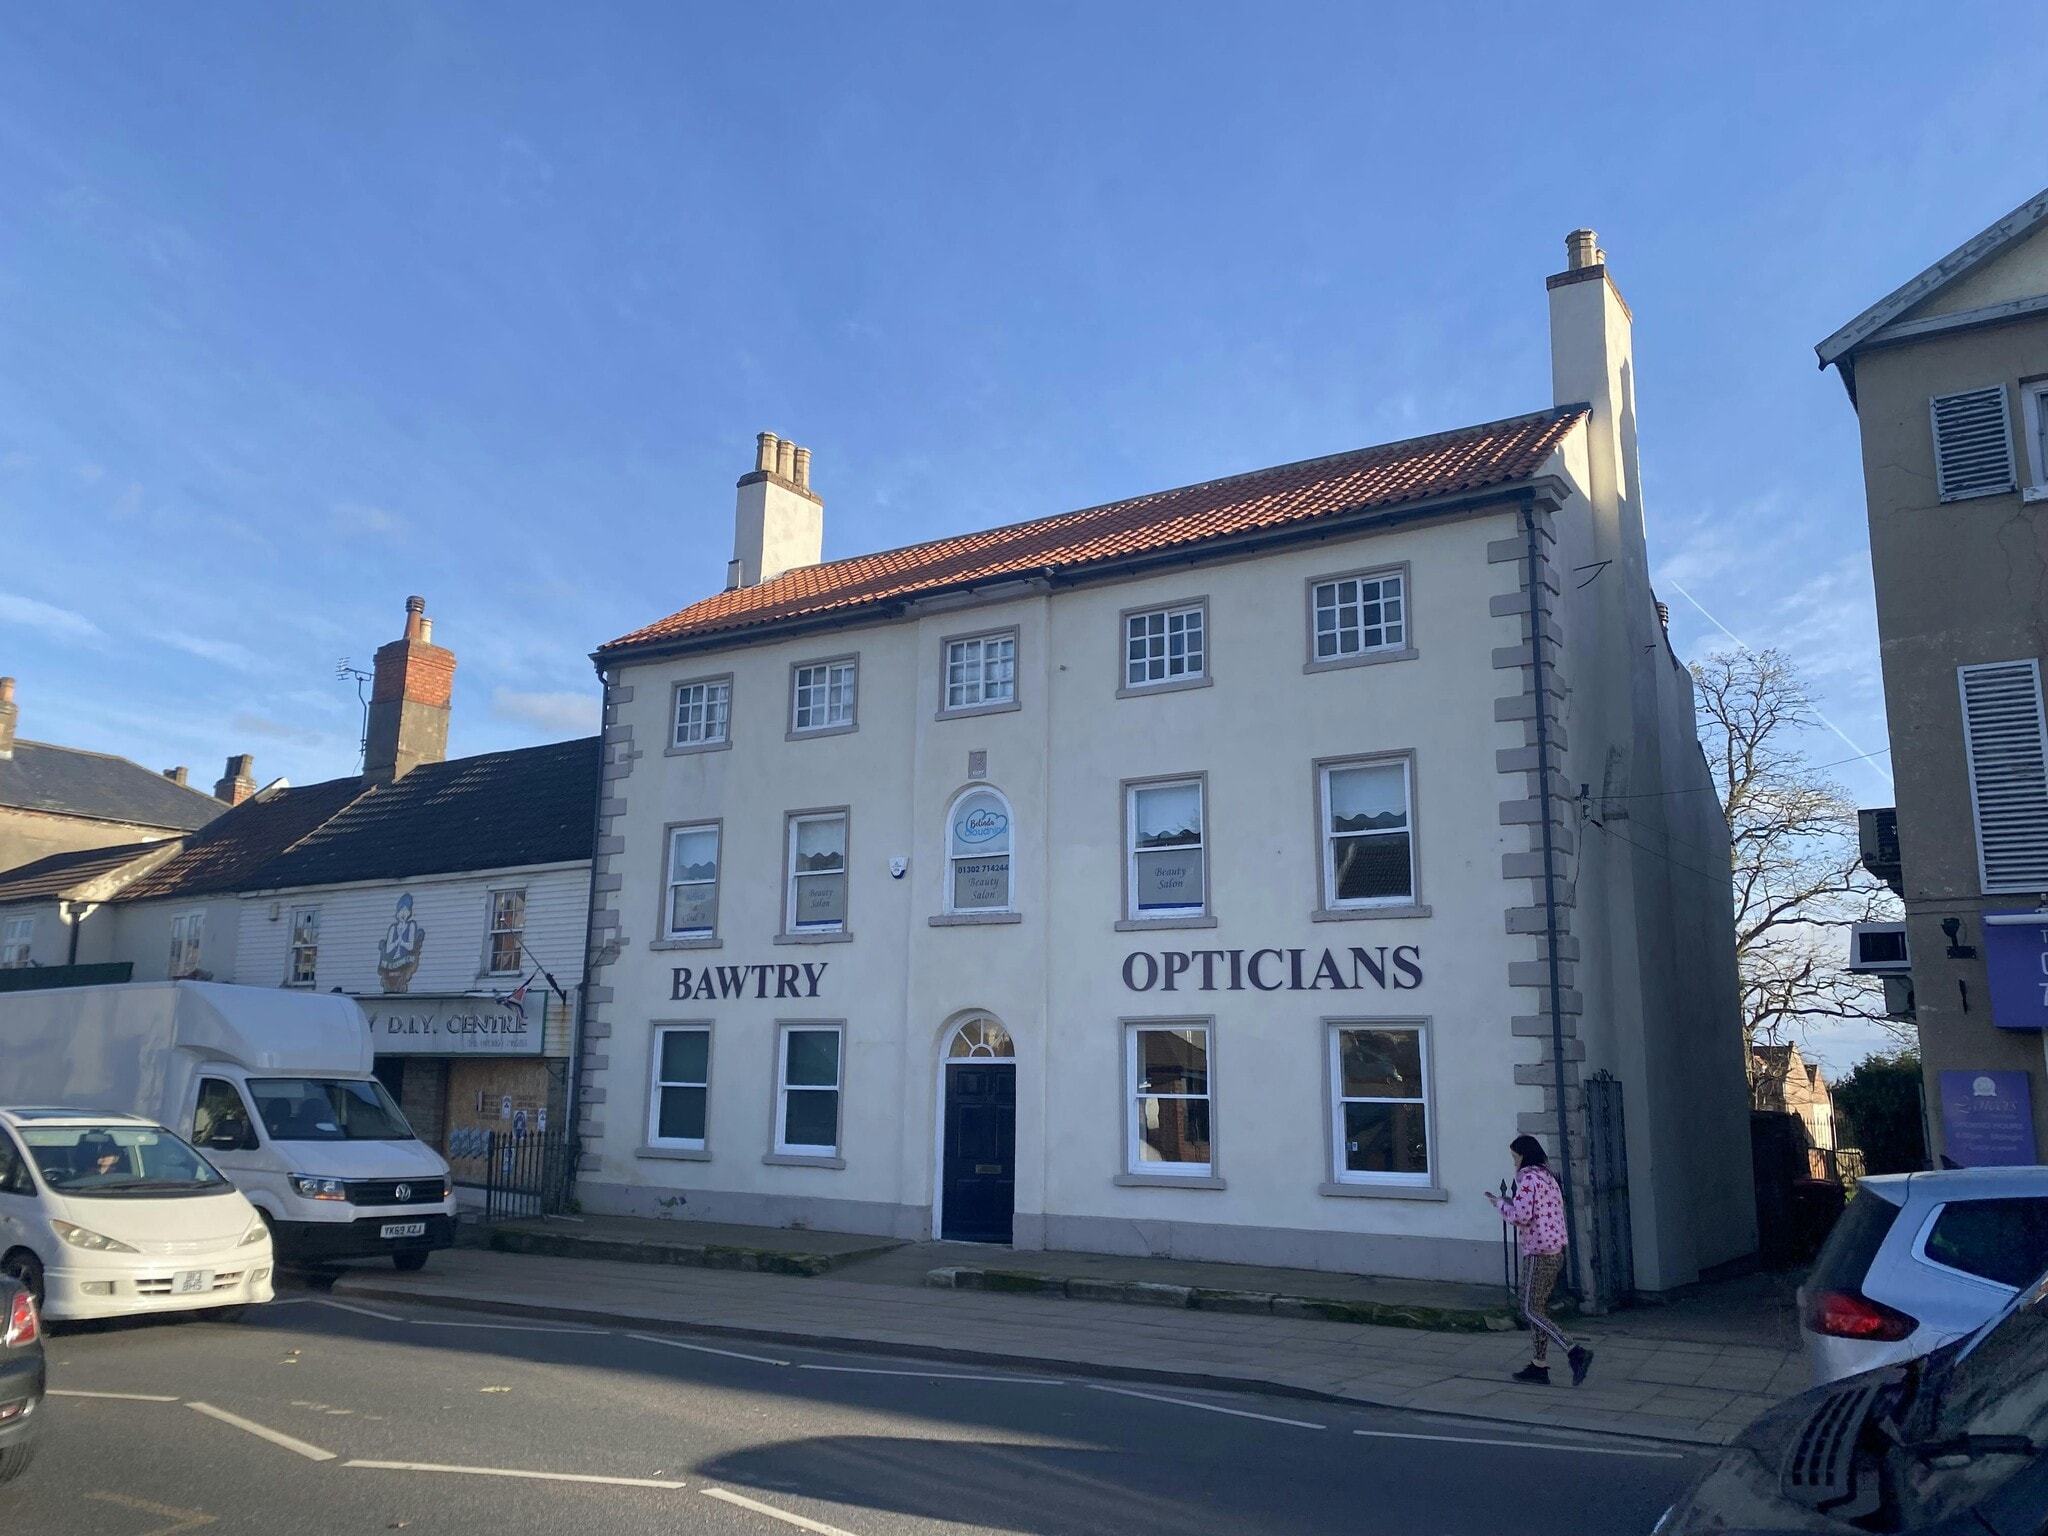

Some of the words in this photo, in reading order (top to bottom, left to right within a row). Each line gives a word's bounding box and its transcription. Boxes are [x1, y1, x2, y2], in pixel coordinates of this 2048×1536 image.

[970, 817, 995, 829] Belinda
[958, 866, 980, 874] 01302
[982, 863, 1009, 873] 714244
[1155, 867, 1187, 878] Beauty
[968, 877, 999, 890] Beauty
[1157, 878, 1184, 889] Salon
[809, 889, 834, 900] Beauty
[972, 890, 996, 900] Salon
[811, 898, 830, 908] Salon
[1122, 945, 1423, 992] OPTICIANS
[669, 962, 829, 1000] BAWTRY
[388, 1015, 438, 1034] D.I.Y.
[446, 1014, 528, 1034] CENTRE
[384, 1225, 405, 1236] YK69
[406, 1224, 422, 1234] XZJ
